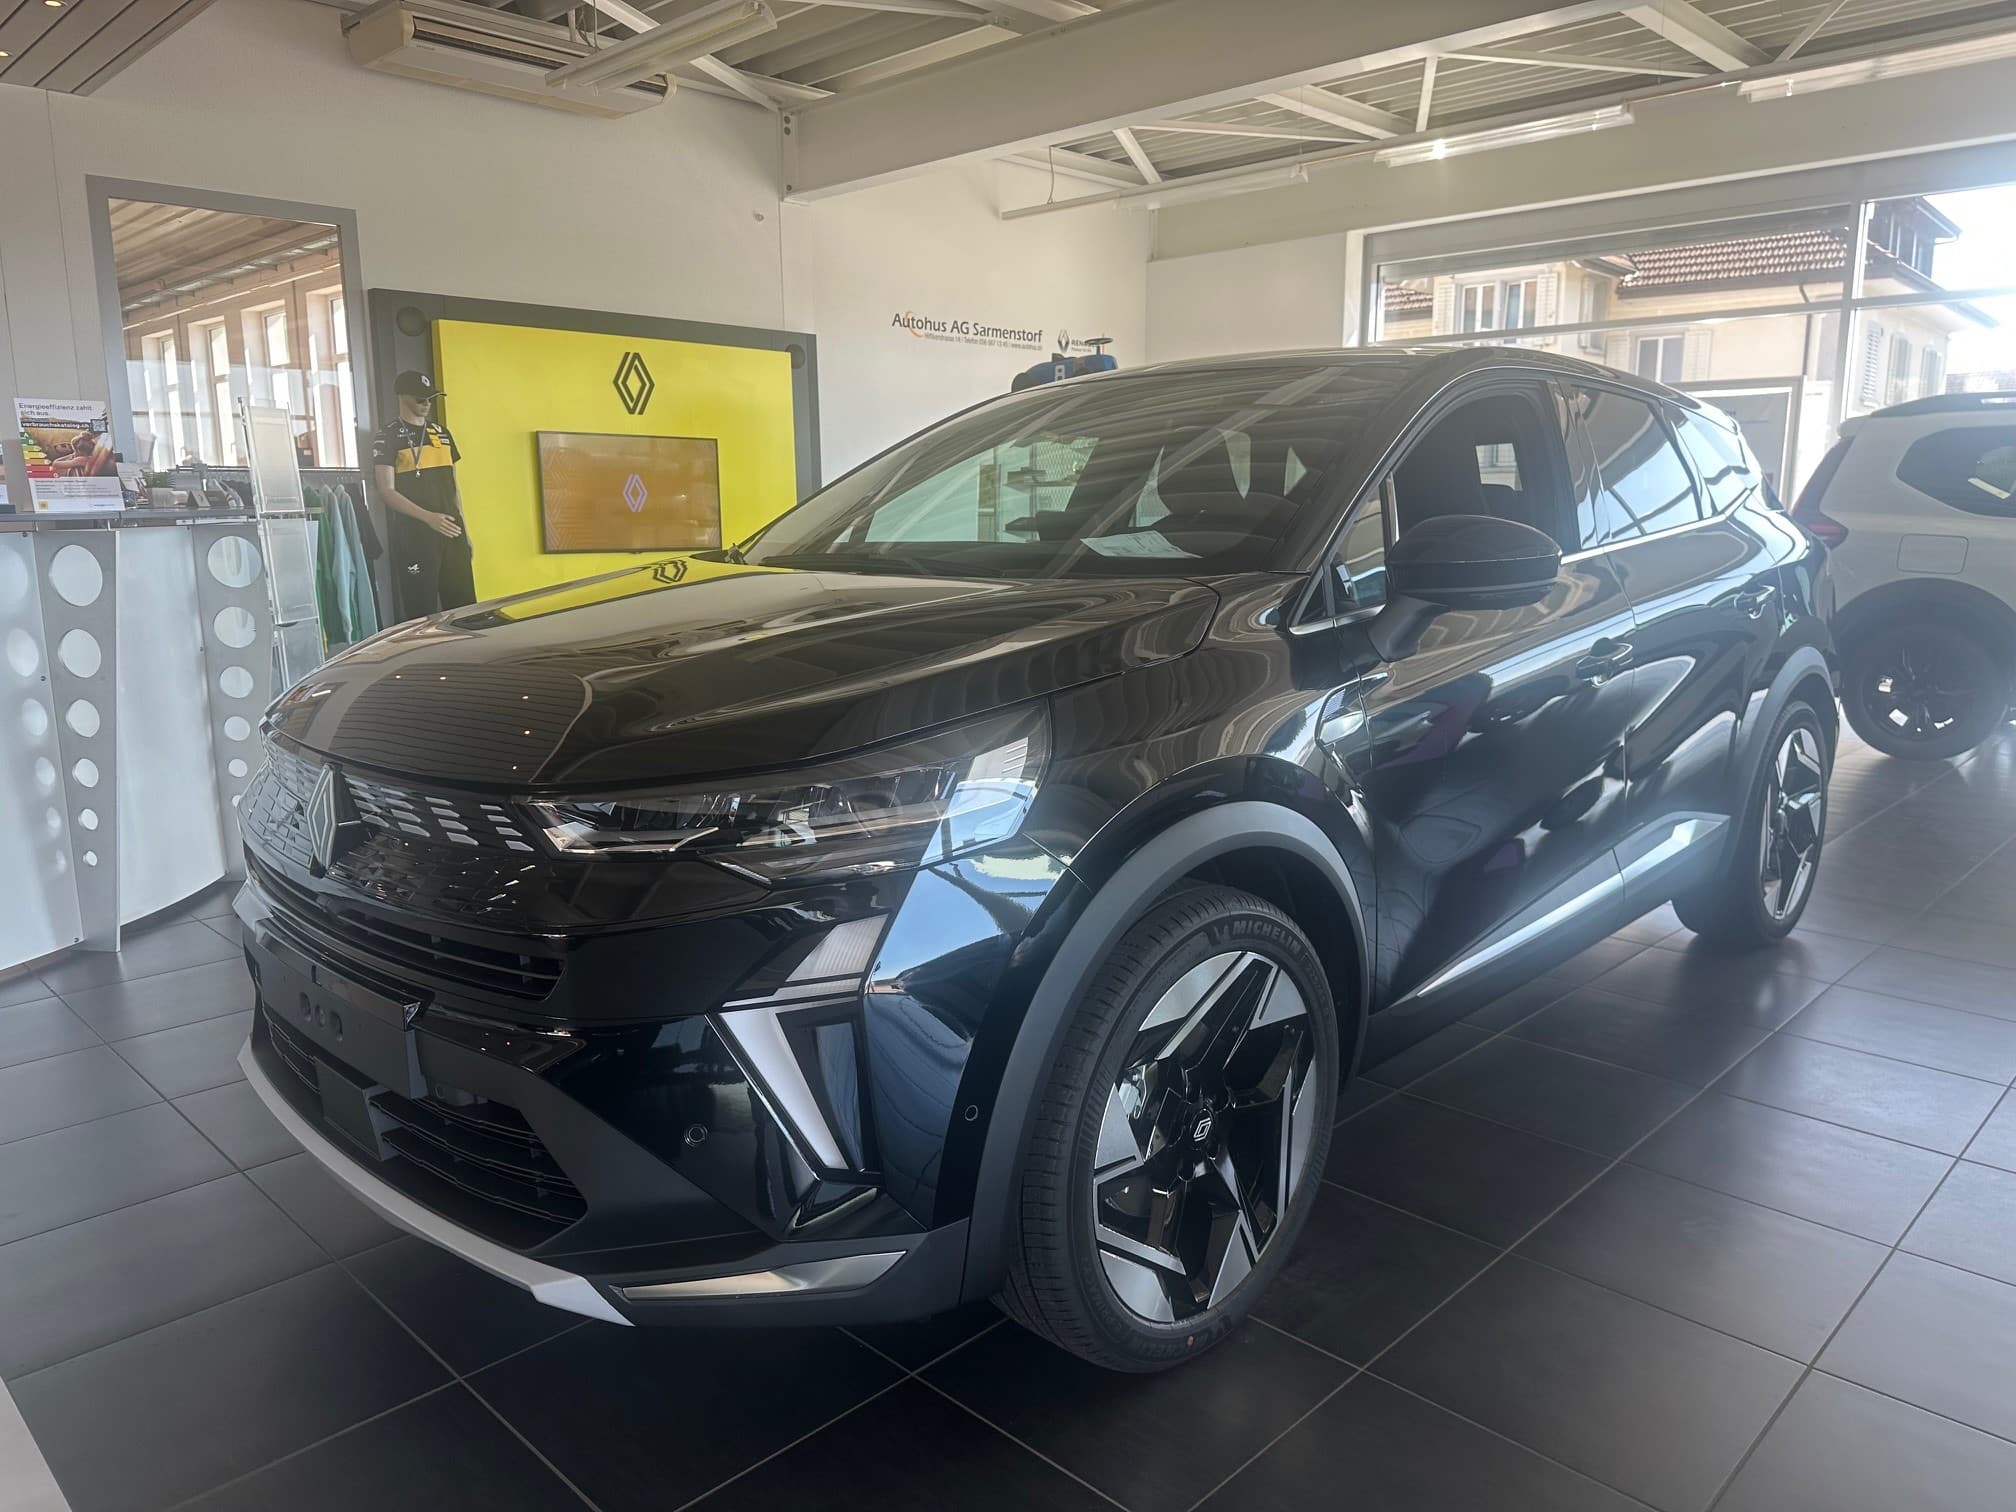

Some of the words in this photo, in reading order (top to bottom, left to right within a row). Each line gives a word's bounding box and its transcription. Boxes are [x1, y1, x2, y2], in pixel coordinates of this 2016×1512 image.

[892, 312, 947, 333] Autohus
[950, 320, 970, 335] AG
[973, 322, 1043, 343] Sarmenstorf
[1232, 920, 1302, 953] MICHELIN
